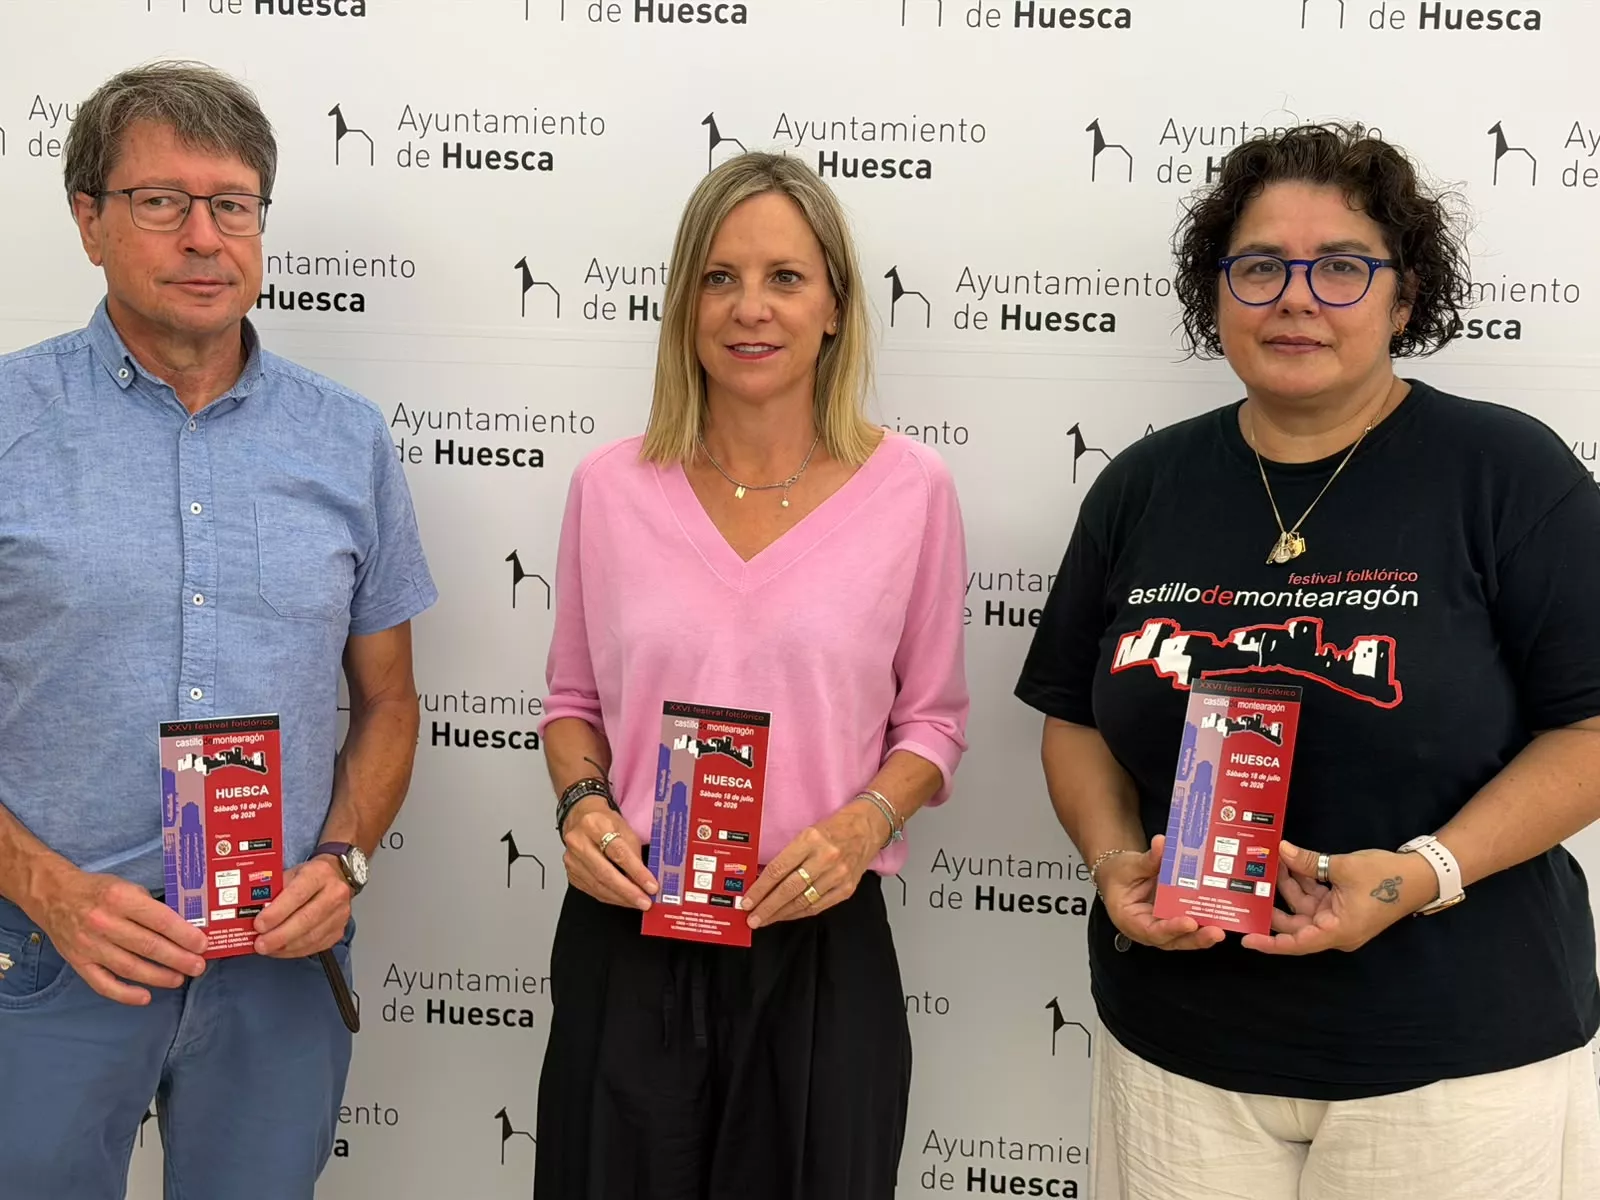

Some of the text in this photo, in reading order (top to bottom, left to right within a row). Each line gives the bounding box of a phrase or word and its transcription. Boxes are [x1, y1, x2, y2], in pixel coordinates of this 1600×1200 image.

[255, 0, 366, 17] Huesca
[588, 0, 747, 24] de Huesca
[967, 0, 1131, 29] de Huesca
[1370, 2, 1541, 30] de Huesca
[398, 104, 604, 138] Ayuntamiento
[773, 113, 985, 147] Ayuntamiento
[29, 131, 61, 157] de
[397, 141, 553, 171] de Huesca
[818, 151, 932, 179] Huesca
[1157, 152, 1192, 183] de
[1562, 160, 1598, 187] de
[268, 250, 415, 278] ntamiento
[956, 266, 1170, 300] Ayuntamiento
[257, 284, 365, 313] Huesca
[584, 294, 616, 320] de
[954, 303, 1115, 332] de Huesca
[391, 402, 595, 436] Ayuntamiento
[435, 439, 544, 468] Huesca
[1288, 568, 1419, 585] festival folklórico
[985, 600, 1043, 628] Hue
[1224, 684, 1256, 693] festival
[670, 704, 690, 712] XXVI
[693, 706, 723, 716] festival
[431, 721, 539, 750] Huesca
[1230, 753, 1280, 767] HUESCA
[703, 774, 752, 789] HUESCA
[1226, 770, 1249, 778] Sábado
[1267, 774, 1280, 782] julio
[216, 785, 269, 799] HUESCA
[700, 790, 722, 798] Sábado
[214, 804, 238, 812] Sábado
[258, 801, 272, 809] julio
[931, 848, 1090, 882] Ayuntamie
[930, 884, 1087, 916] de Huesca
[382, 962, 551, 996] Ayuntamien
[383, 997, 533, 1028] de Huesca
[921, 1164, 1077, 1199] de Huesca
